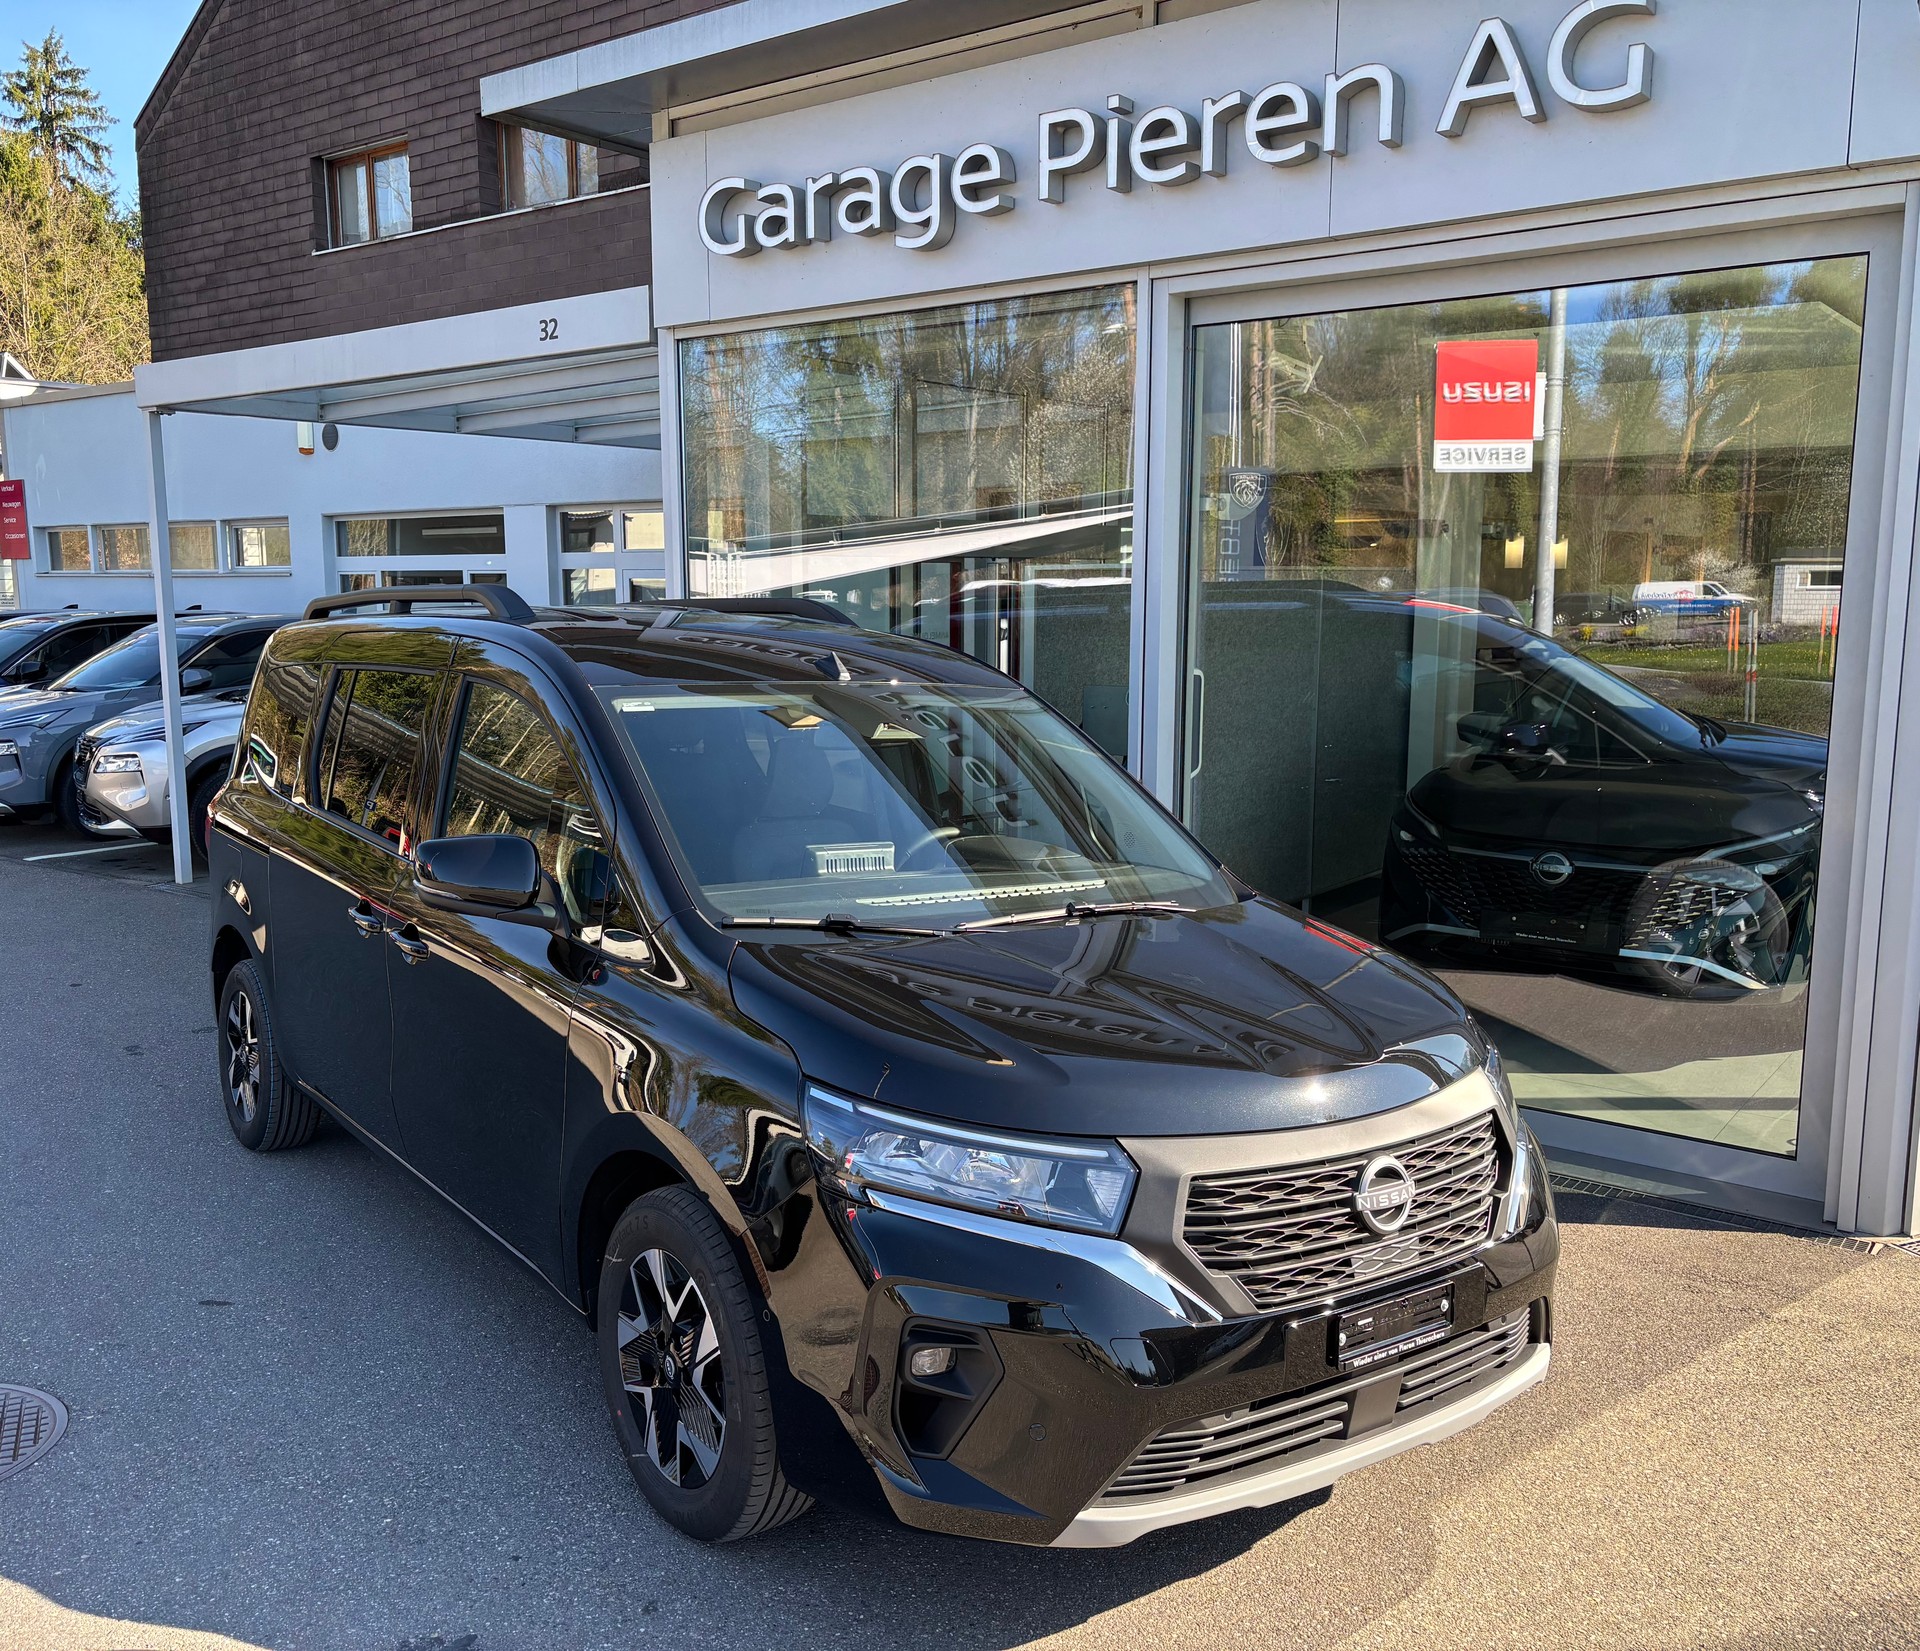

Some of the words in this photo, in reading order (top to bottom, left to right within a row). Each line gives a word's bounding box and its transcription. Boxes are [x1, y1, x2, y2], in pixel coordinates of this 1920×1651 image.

[699, 143, 1016, 259] Garage
[1038, 62, 1406, 205] Pieren
[1435, 0, 1657, 139] AG
[539, 318, 559, 342] 32
[1357, 1184, 1416, 1211] NISSAN
[1353, 1355, 1373, 1368] Wieder
[1373, 1351, 1388, 1361] einer
[1388, 1347, 1398, 1356] von
[1398, 1341, 1416, 1352] Pieren
